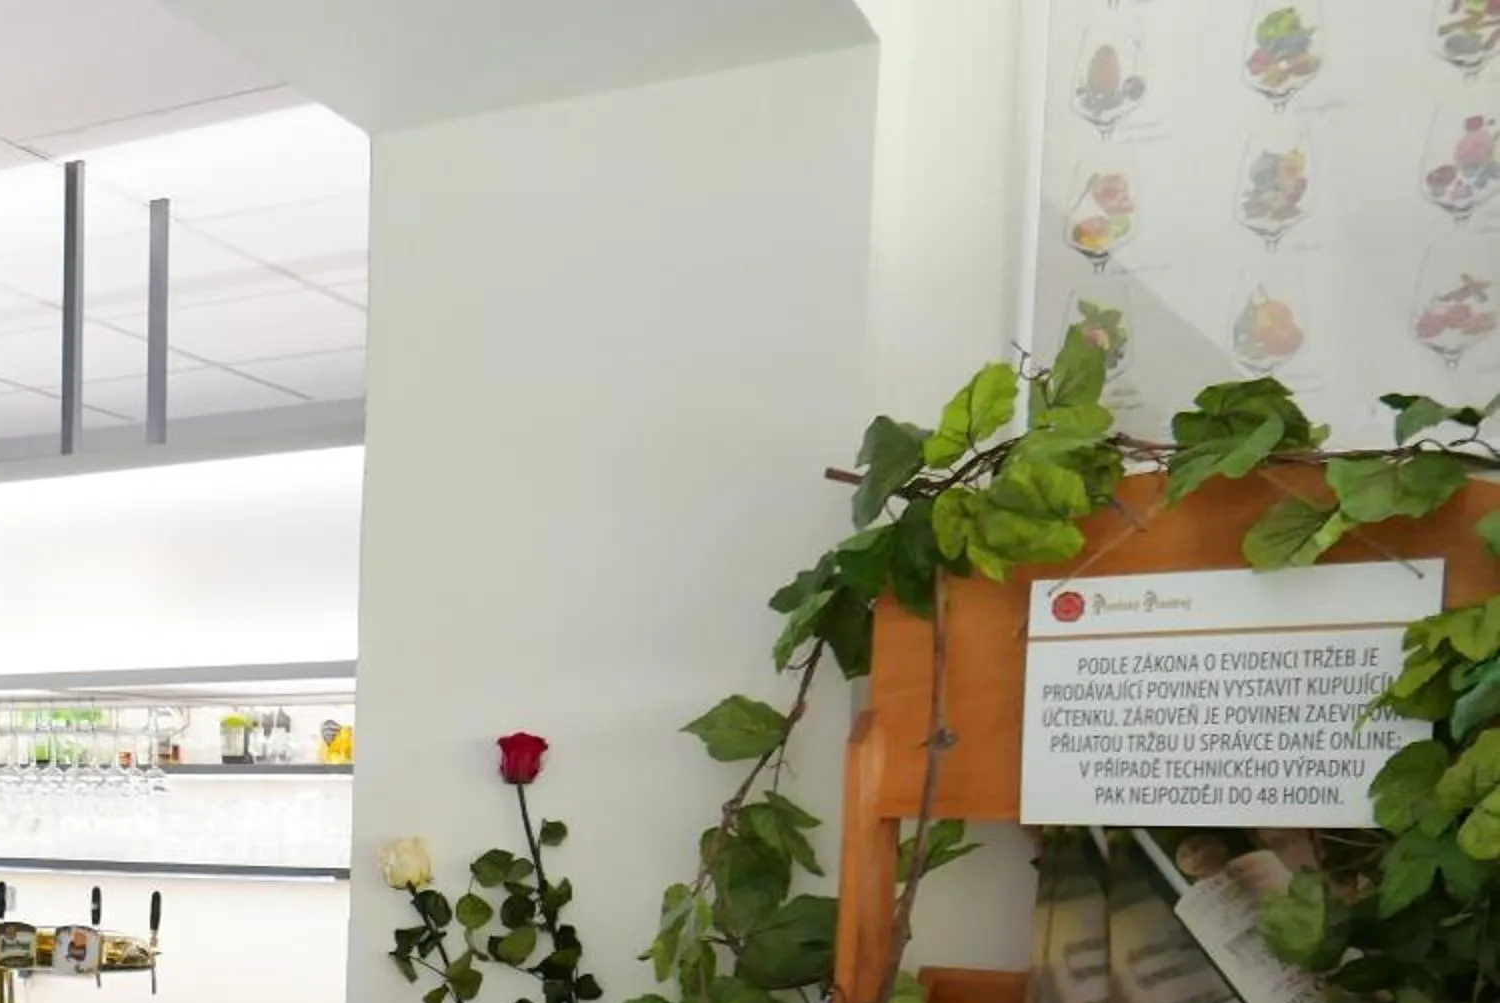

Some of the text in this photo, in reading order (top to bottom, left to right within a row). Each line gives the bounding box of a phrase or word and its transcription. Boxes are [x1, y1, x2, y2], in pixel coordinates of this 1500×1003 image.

[1077, 645, 1380, 676] PODLE ZÁKONA O EVIDENCI TRŽEB JE
[1042, 678, 1143, 702] PRODÁVAJÍCÍ
[1147, 678, 1219, 700] POVINEN
[1223, 676, 1302, 699] VYSTAVIT
[1042, 705, 1119, 728] ÚČTENKU.
[1122, 702, 1199, 728] ZÁROVEŇ
[1202, 705, 1220, 726] JE
[1225, 702, 1300, 725] POVINEN
[1050, 731, 1123, 753] PŘIJATOU
[1127, 730, 1178, 753] TRŽBU
[1183, 732, 1195, 751] U
[1199, 729, 1273, 752] SPRÁVCE
[1079, 754, 1366, 779] V PŘÍPADĚ TECHNICKÉHO VÝPADKU
[1094, 782, 1345, 806] PAK NEJPOZDĚJI DO 48 HODIN.
